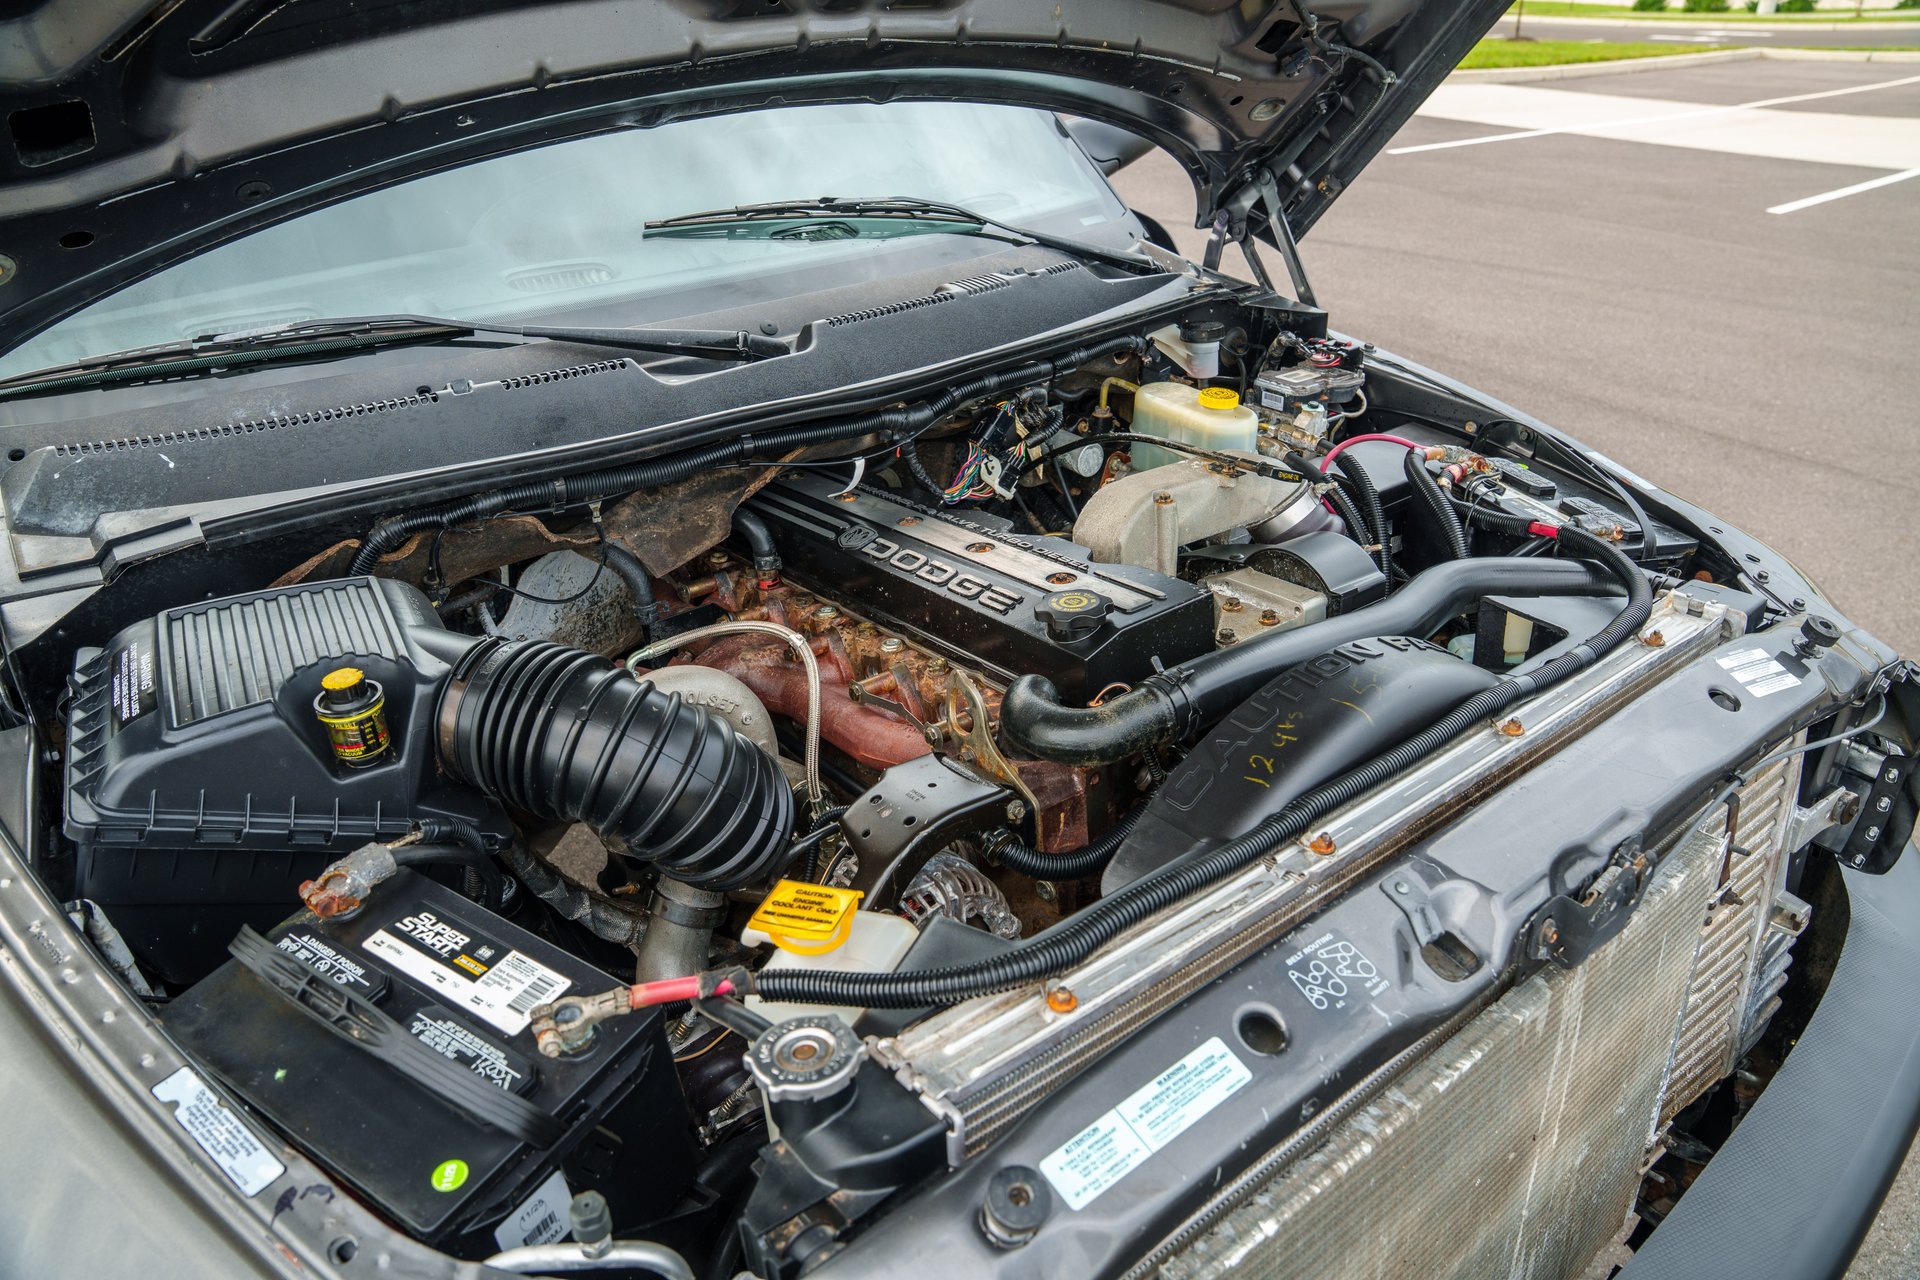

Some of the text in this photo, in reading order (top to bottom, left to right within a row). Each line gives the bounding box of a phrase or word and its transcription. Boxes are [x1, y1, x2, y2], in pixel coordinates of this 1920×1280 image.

[937, 511, 981, 529] VALVE
[981, 527, 1033, 549] TURBO
[1032, 547, 1089, 571] DIESEL
[862, 537, 1024, 616] DODGE
[140, 651, 152, 690] WARNING
[1165, 643, 1384, 811] CAUTION
[1243, 754, 1274, 788] 12
[771, 900, 839, 915] COOLANT ONLY
[792, 897, 825, 906] ENGINE
[795, 888, 834, 899] CAUTION
[394, 916, 462, 953] START
[416, 911, 471, 947] SUPER
[1285, 932, 1334, 966] BELT ROUTING
[1156, 1062, 1188, 1087] WARNING
[1062, 1125, 1100, 1155] ATTENTION
[520, 1198, 545, 1224] 11/25
